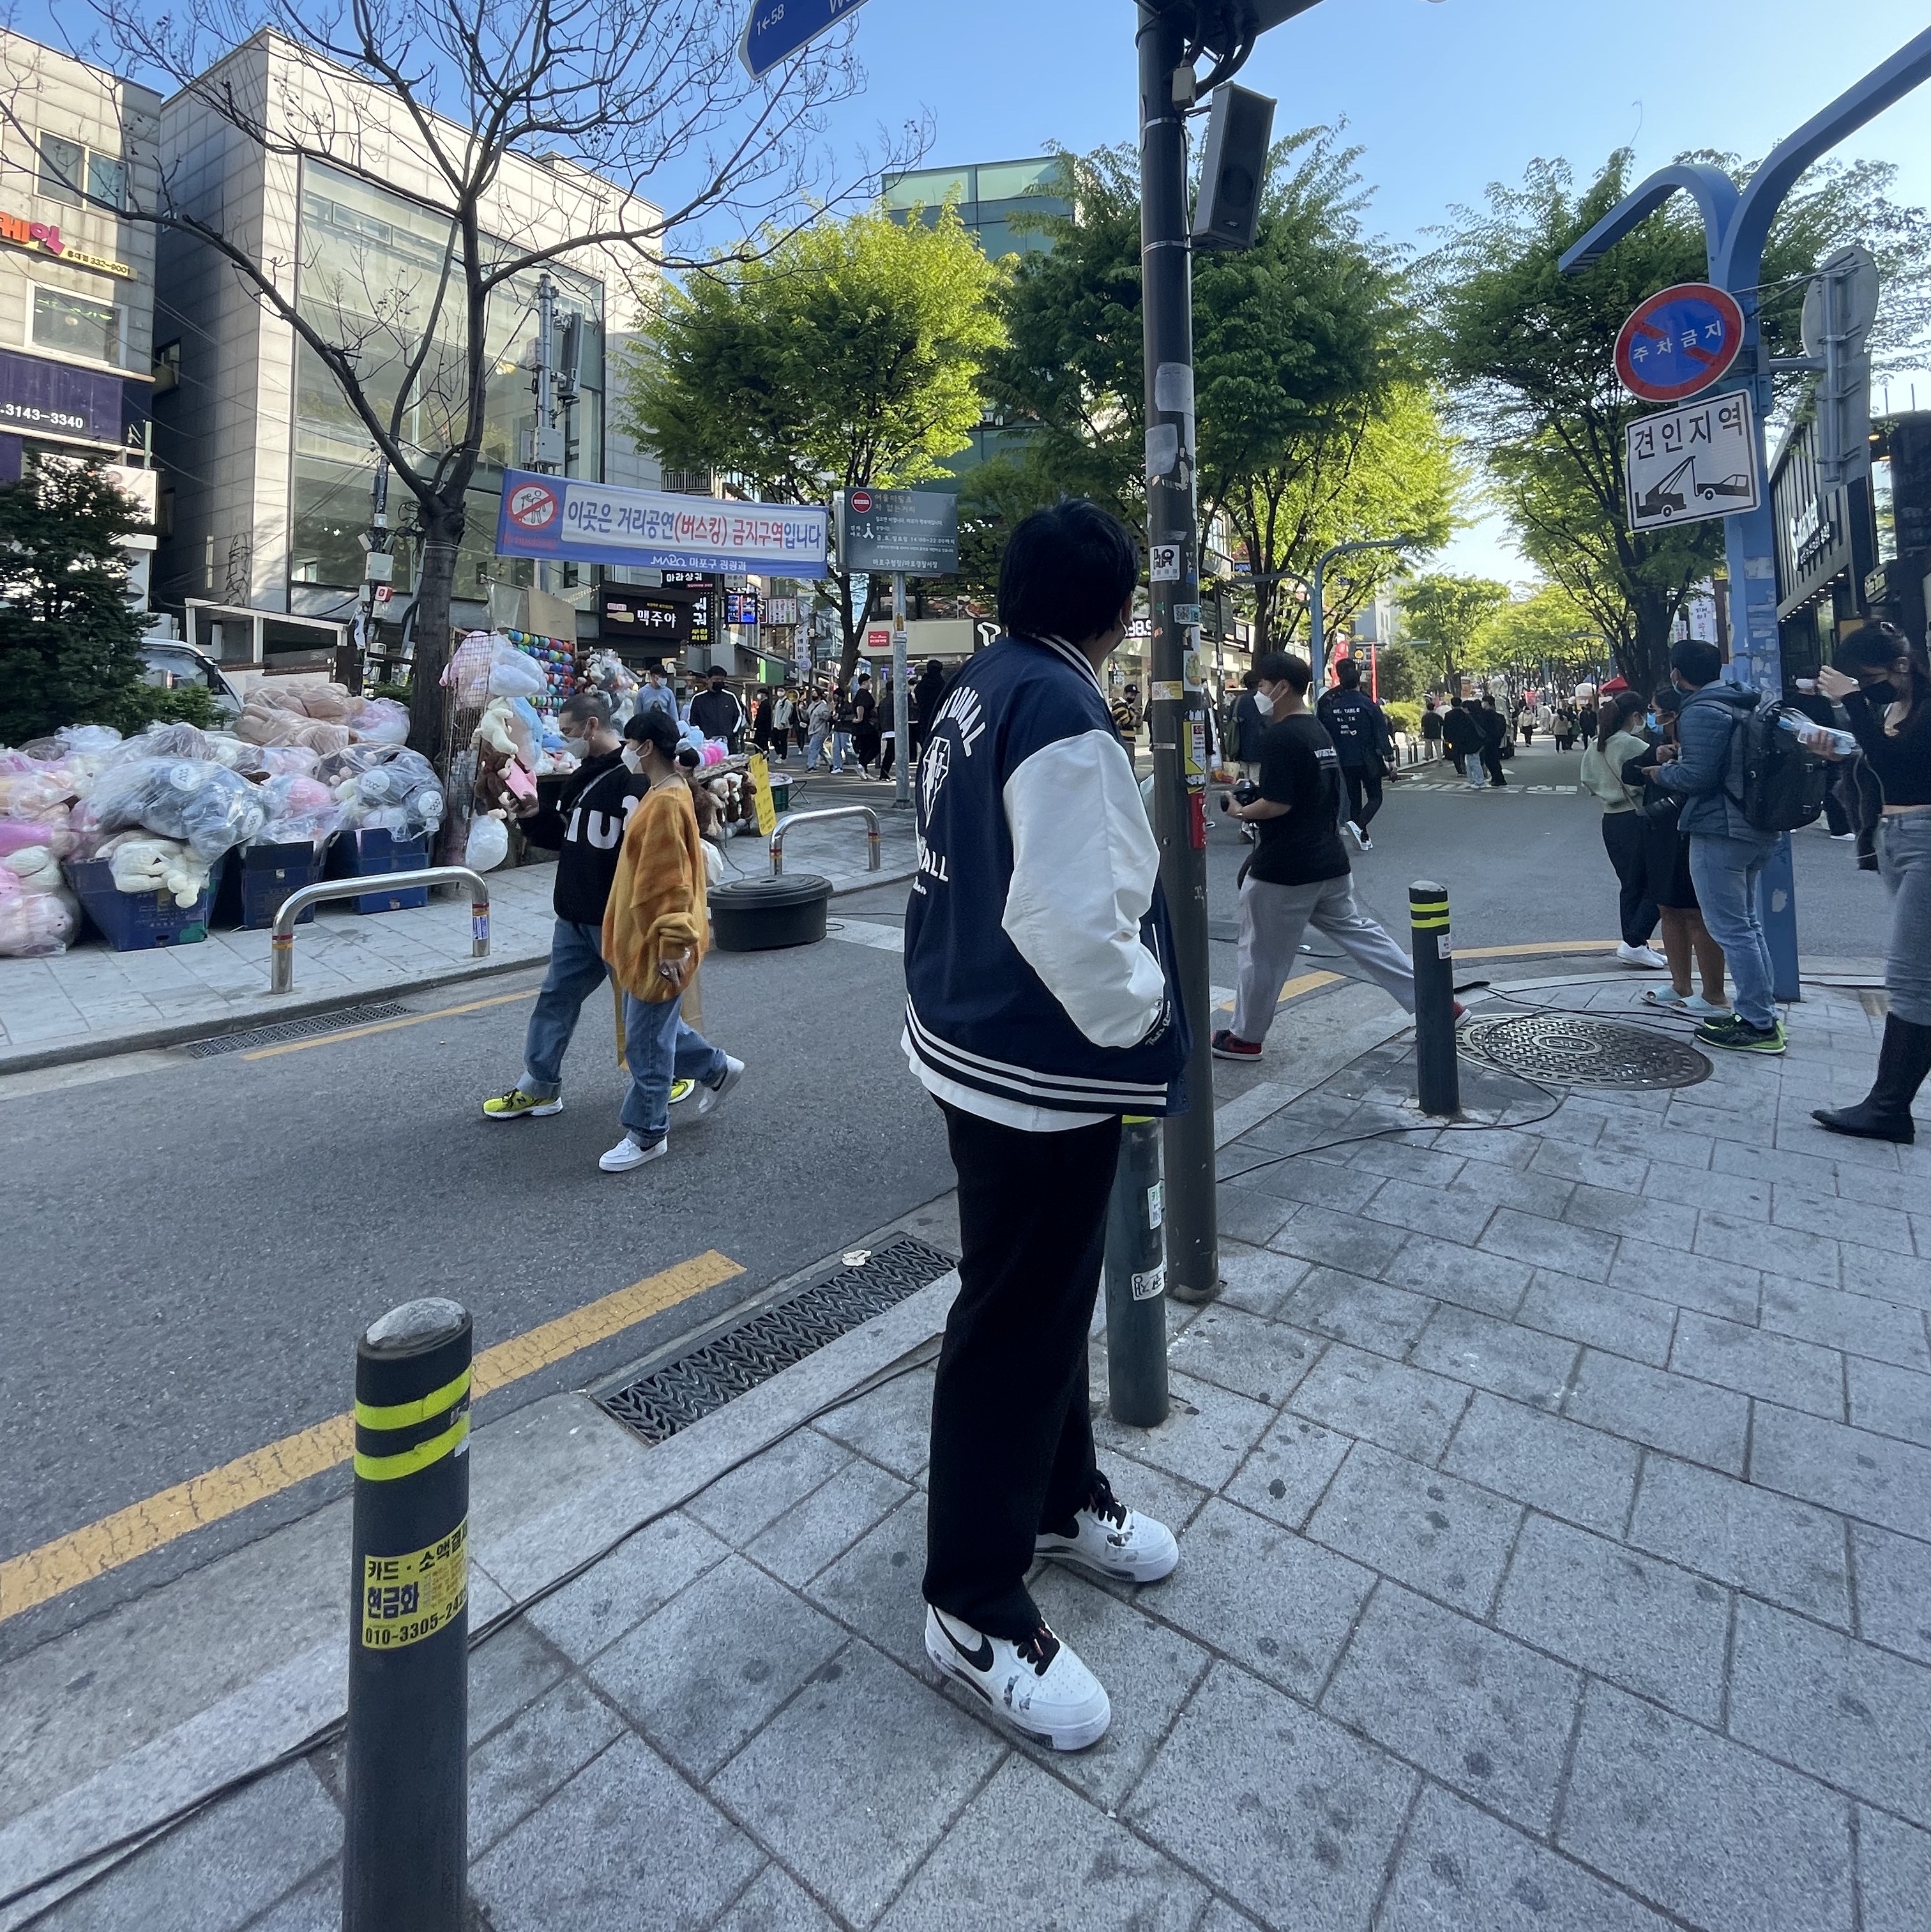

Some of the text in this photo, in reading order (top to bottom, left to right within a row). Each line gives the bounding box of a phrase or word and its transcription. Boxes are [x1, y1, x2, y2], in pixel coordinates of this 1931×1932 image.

[1633, 320, 1722, 363] 주차금지
[0, 402, 84, 429] .3143-3340
[1634, 402, 1743, 460] 견인지역
[568, 500, 821, 549] 이곳은 거리공연(버스킹) 금지구역입니다
[689, 556, 717, 570] 마포구
[637, 609, 677, 628] 맥주야
[368, 1560, 399, 1581] 카드
[367, 1581, 420, 1619] 현금화
